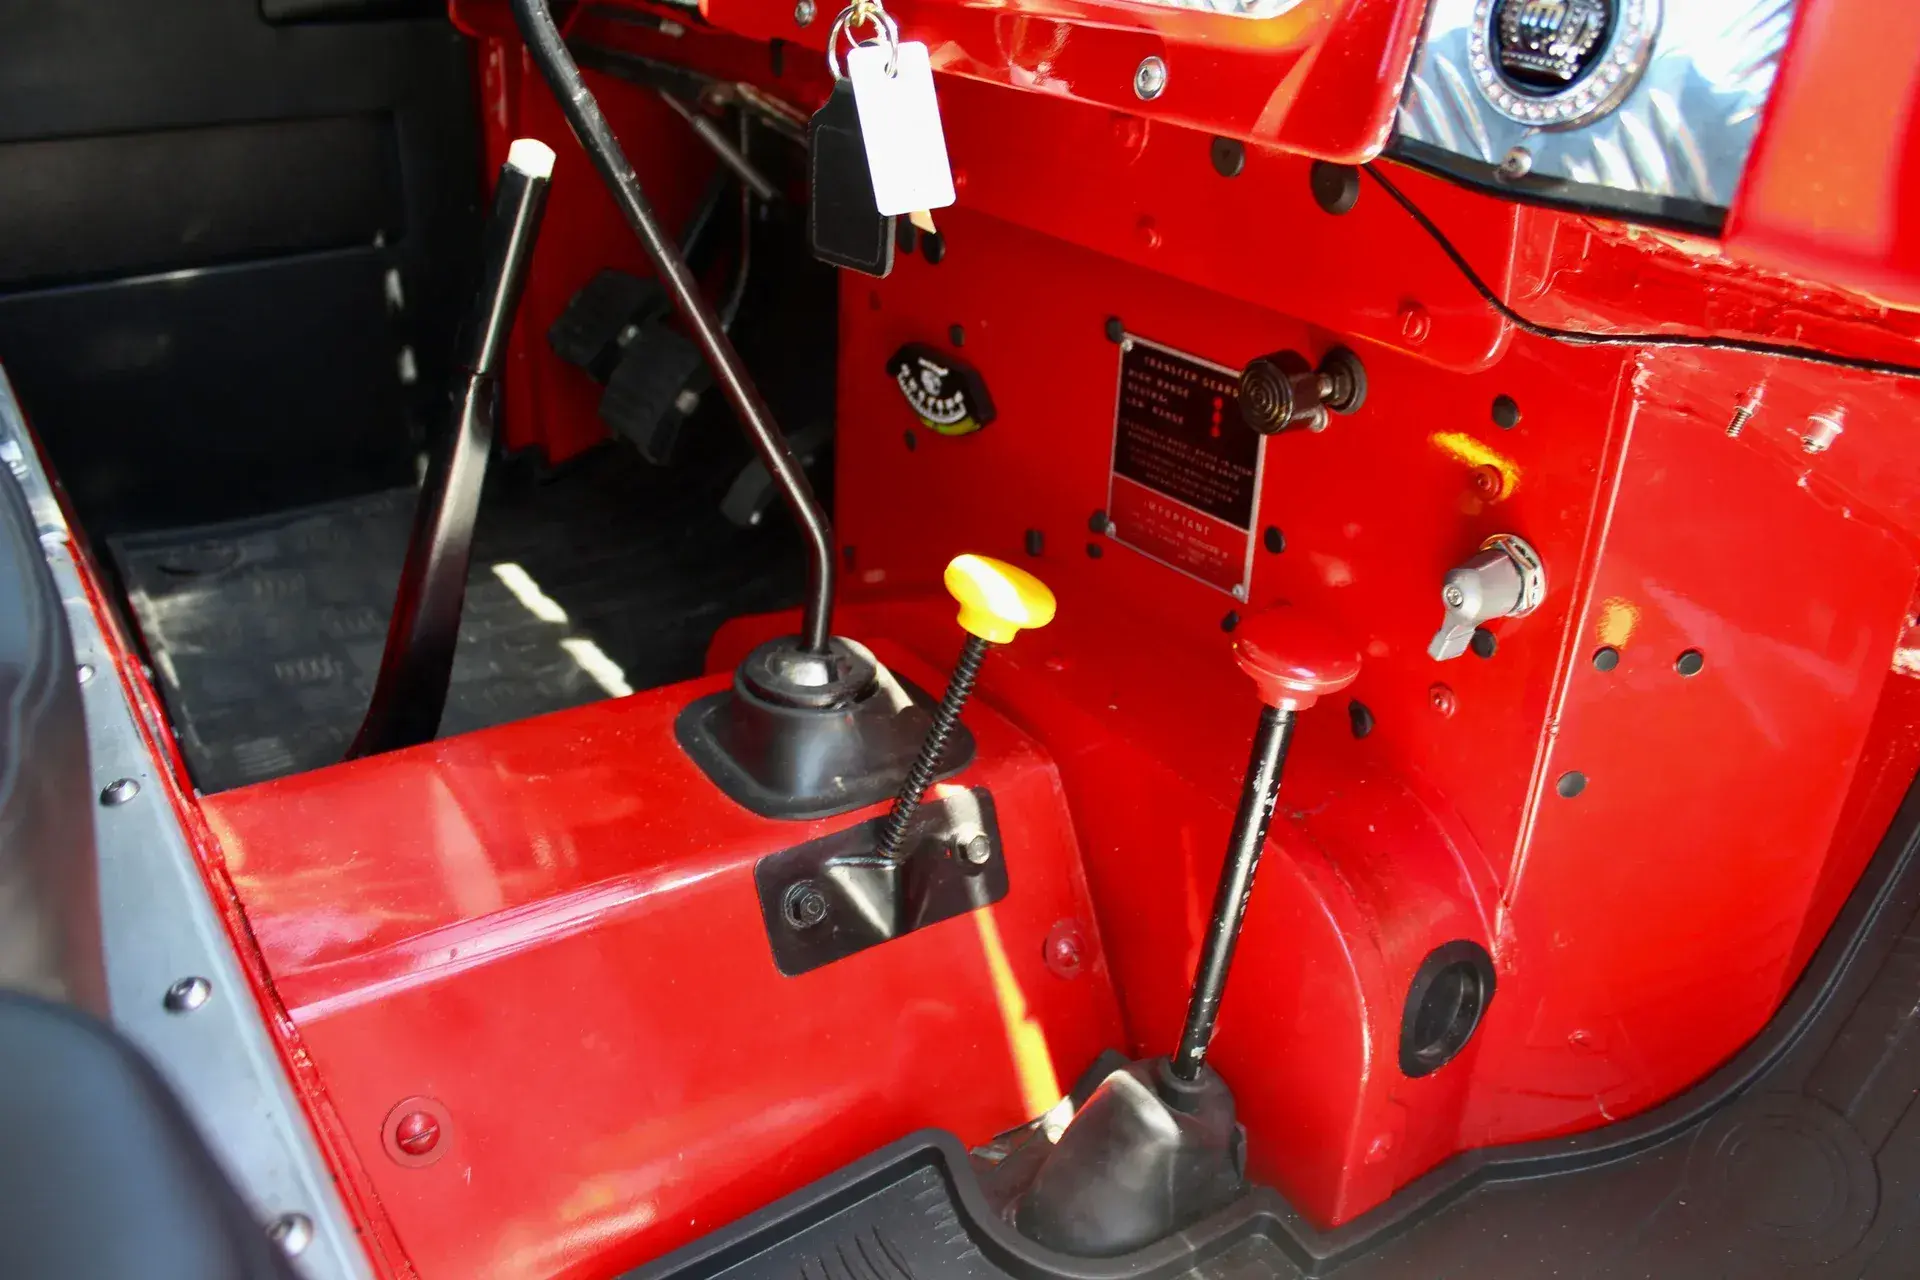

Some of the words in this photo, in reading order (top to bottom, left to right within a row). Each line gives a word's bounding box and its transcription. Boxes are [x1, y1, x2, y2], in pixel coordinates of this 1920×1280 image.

[1144, 356, 1197, 380] TRANSFER
[1203, 377, 1239, 398] GEARS
[1144, 500, 1209, 535] IMPORTANT
